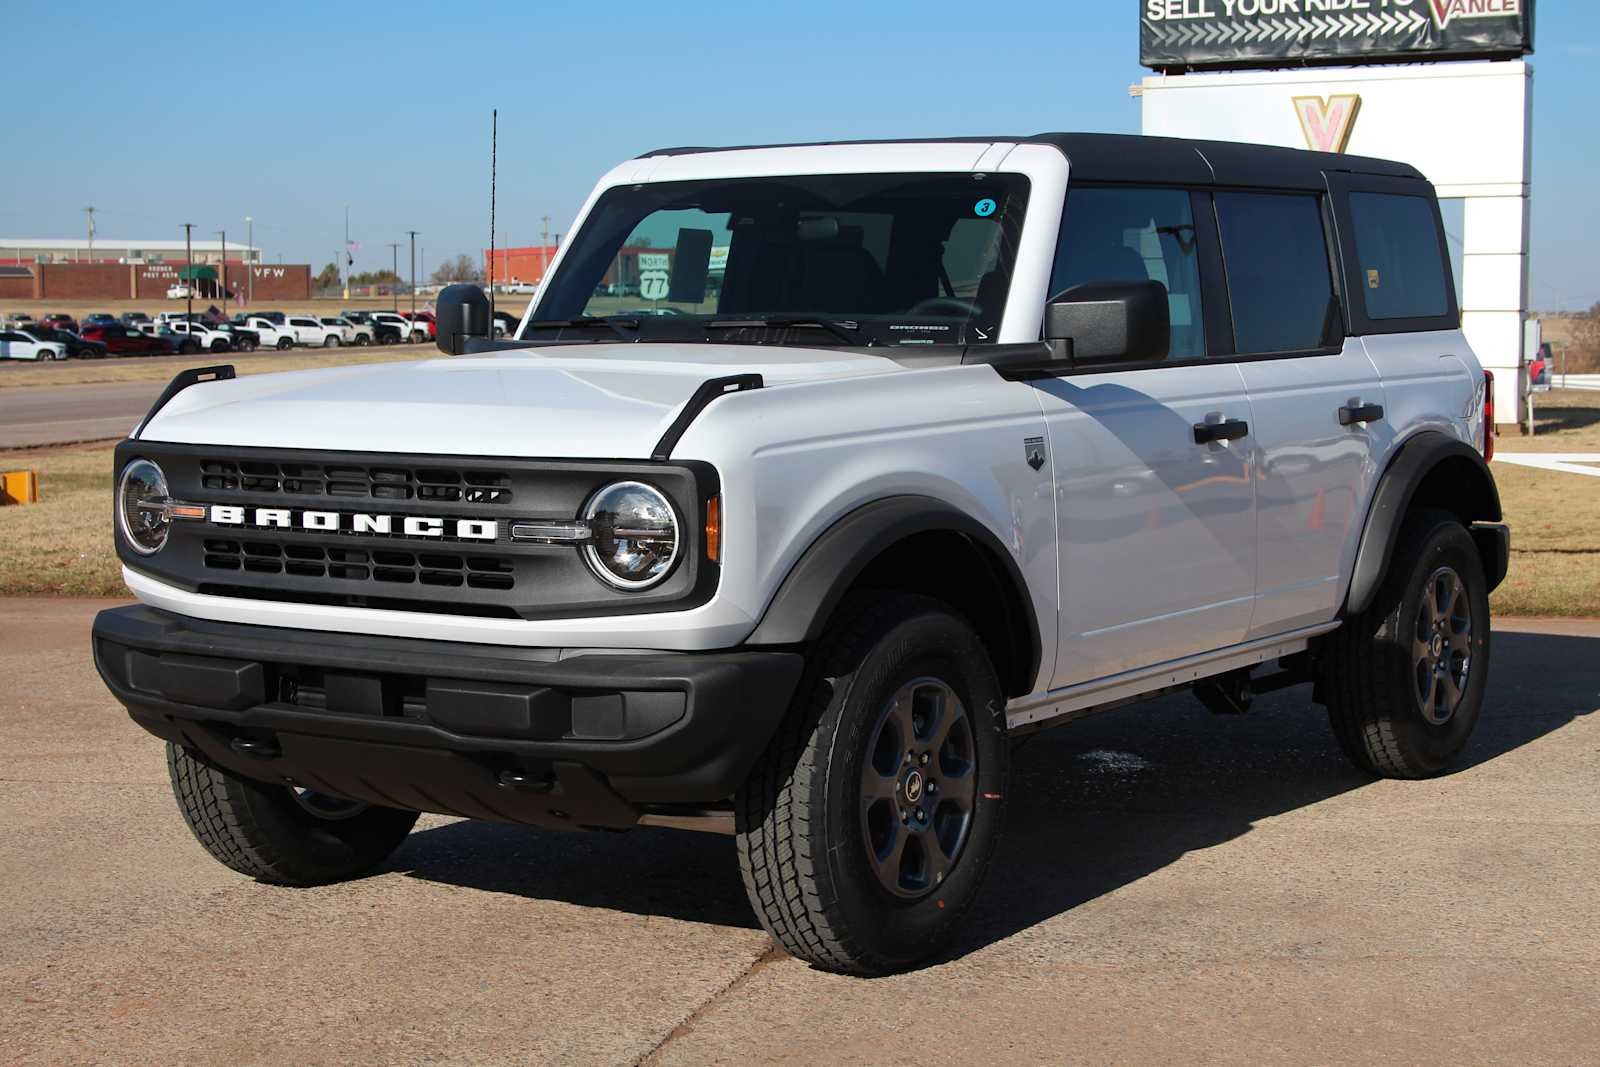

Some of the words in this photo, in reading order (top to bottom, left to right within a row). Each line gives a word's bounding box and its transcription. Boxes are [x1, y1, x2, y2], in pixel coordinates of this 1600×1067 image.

[1147, 0, 1215, 20] SELL
[1223, 0, 1300, 17] YOUR
[641, 256, 668, 266] NORTH
[254, 268, 285, 278] VFW
[643, 278, 666, 294] 77
[210, 505, 498, 540] BRONCO
